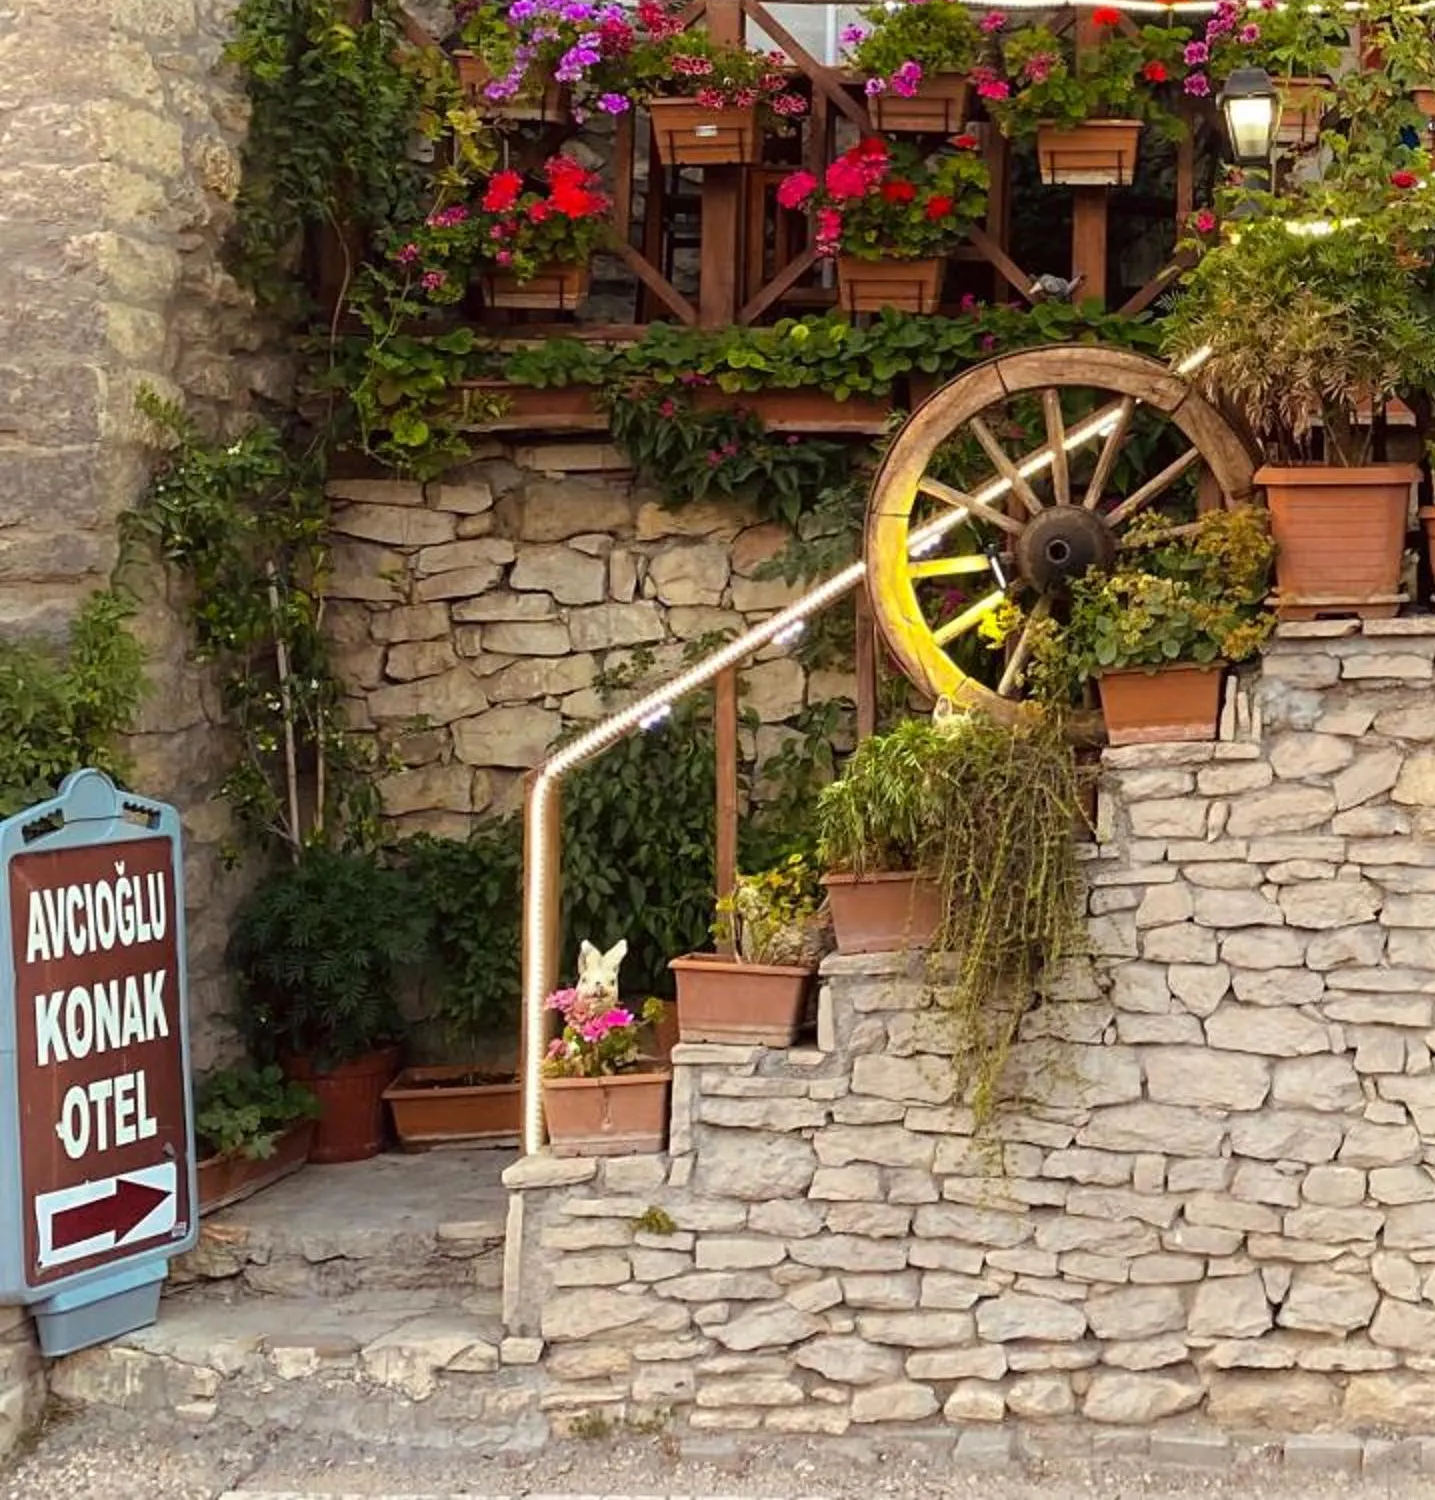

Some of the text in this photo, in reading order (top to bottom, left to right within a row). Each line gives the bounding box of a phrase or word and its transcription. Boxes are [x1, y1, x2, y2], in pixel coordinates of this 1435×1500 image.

[26, 860, 166, 964] AVCIOĞLU
[35, 969, 169, 1067] KONAK
[60, 1069, 158, 1160] OTEL
